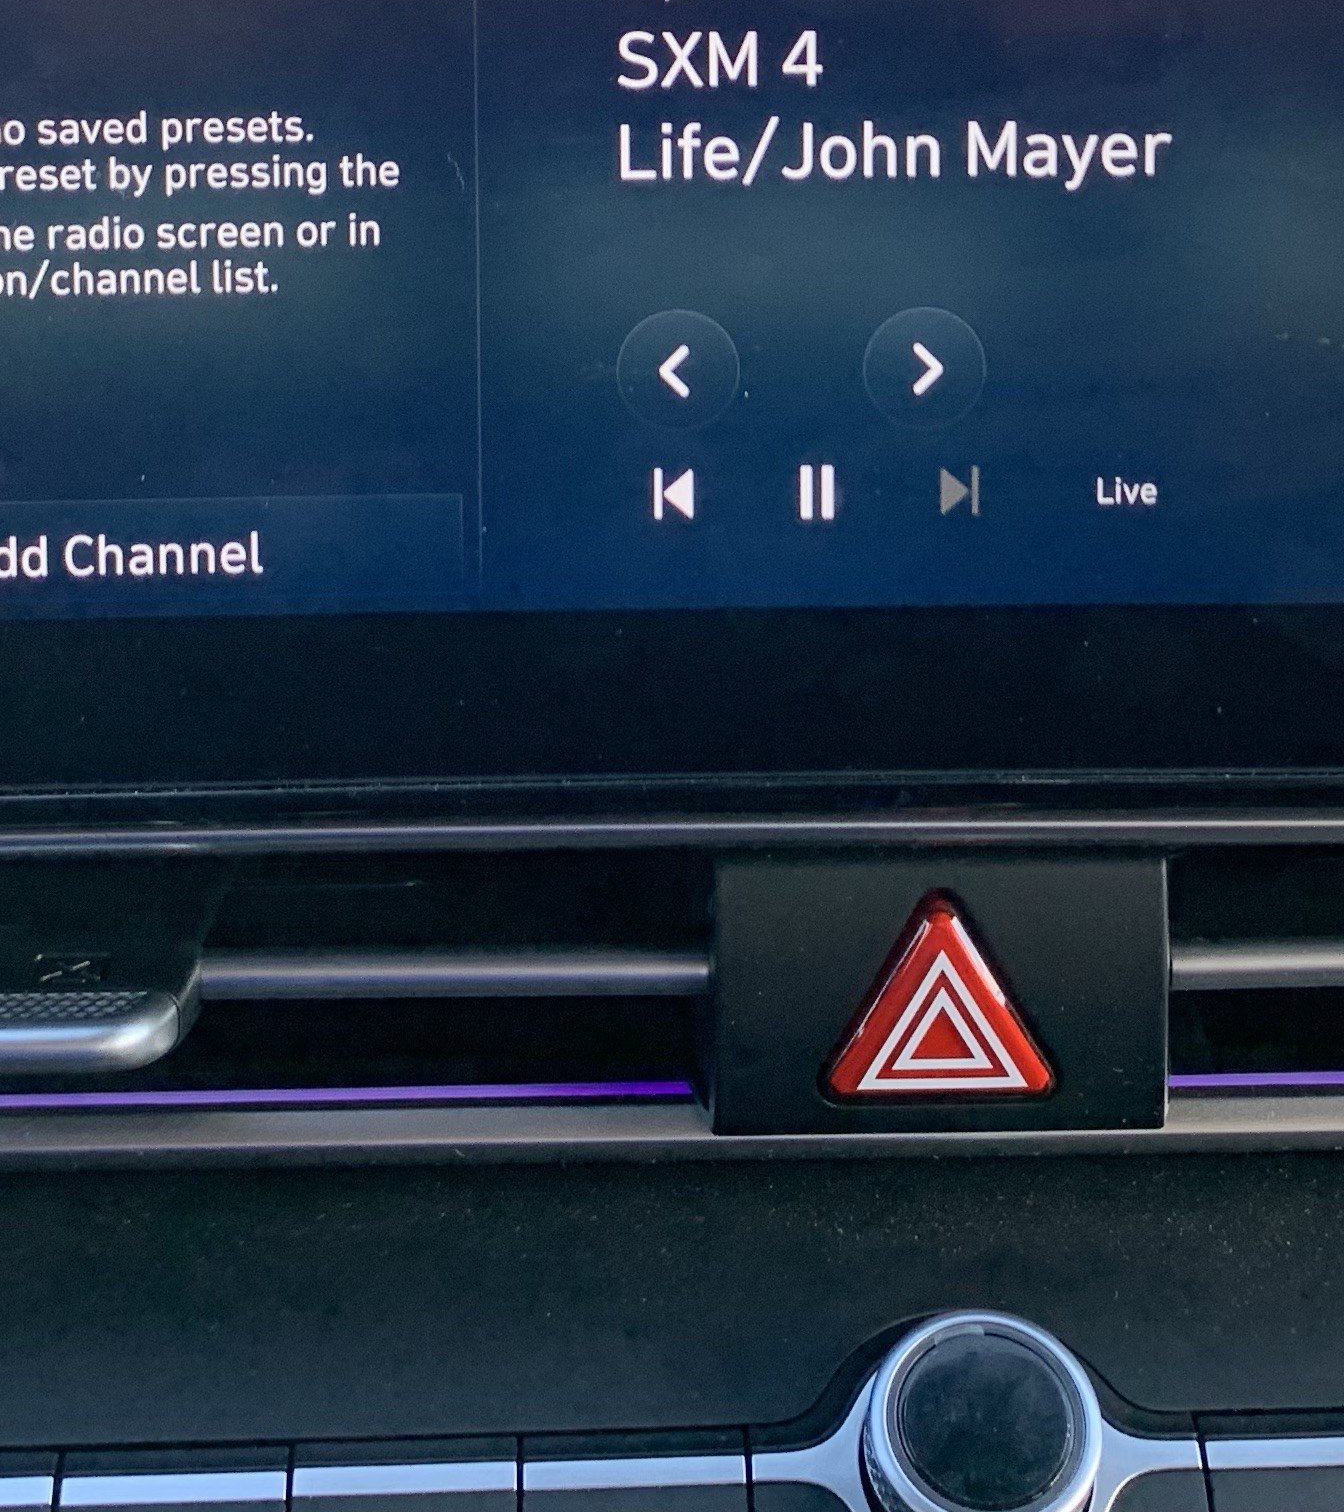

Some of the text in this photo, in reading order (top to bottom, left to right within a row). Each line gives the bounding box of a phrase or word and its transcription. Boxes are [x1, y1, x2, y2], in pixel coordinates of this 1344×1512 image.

[617, 29, 824, 91] SXM 4
[37, 109, 148, 146] saved
[161, 110, 314, 152] presets.
[108, 155, 153, 198] by
[165, 154, 327, 198] pressing
[338, 152, 400, 188] the
[619, 115, 1173, 191] Life/John Mayer
[47, 215, 145, 251] radio
[156, 221, 284, 250] screen
[296, 220, 337, 248] or
[348, 212, 381, 247] in
[212, 259, 279, 295] list.
[1096, 476, 1158, 506] Live
[64, 530, 264, 578] Channel
